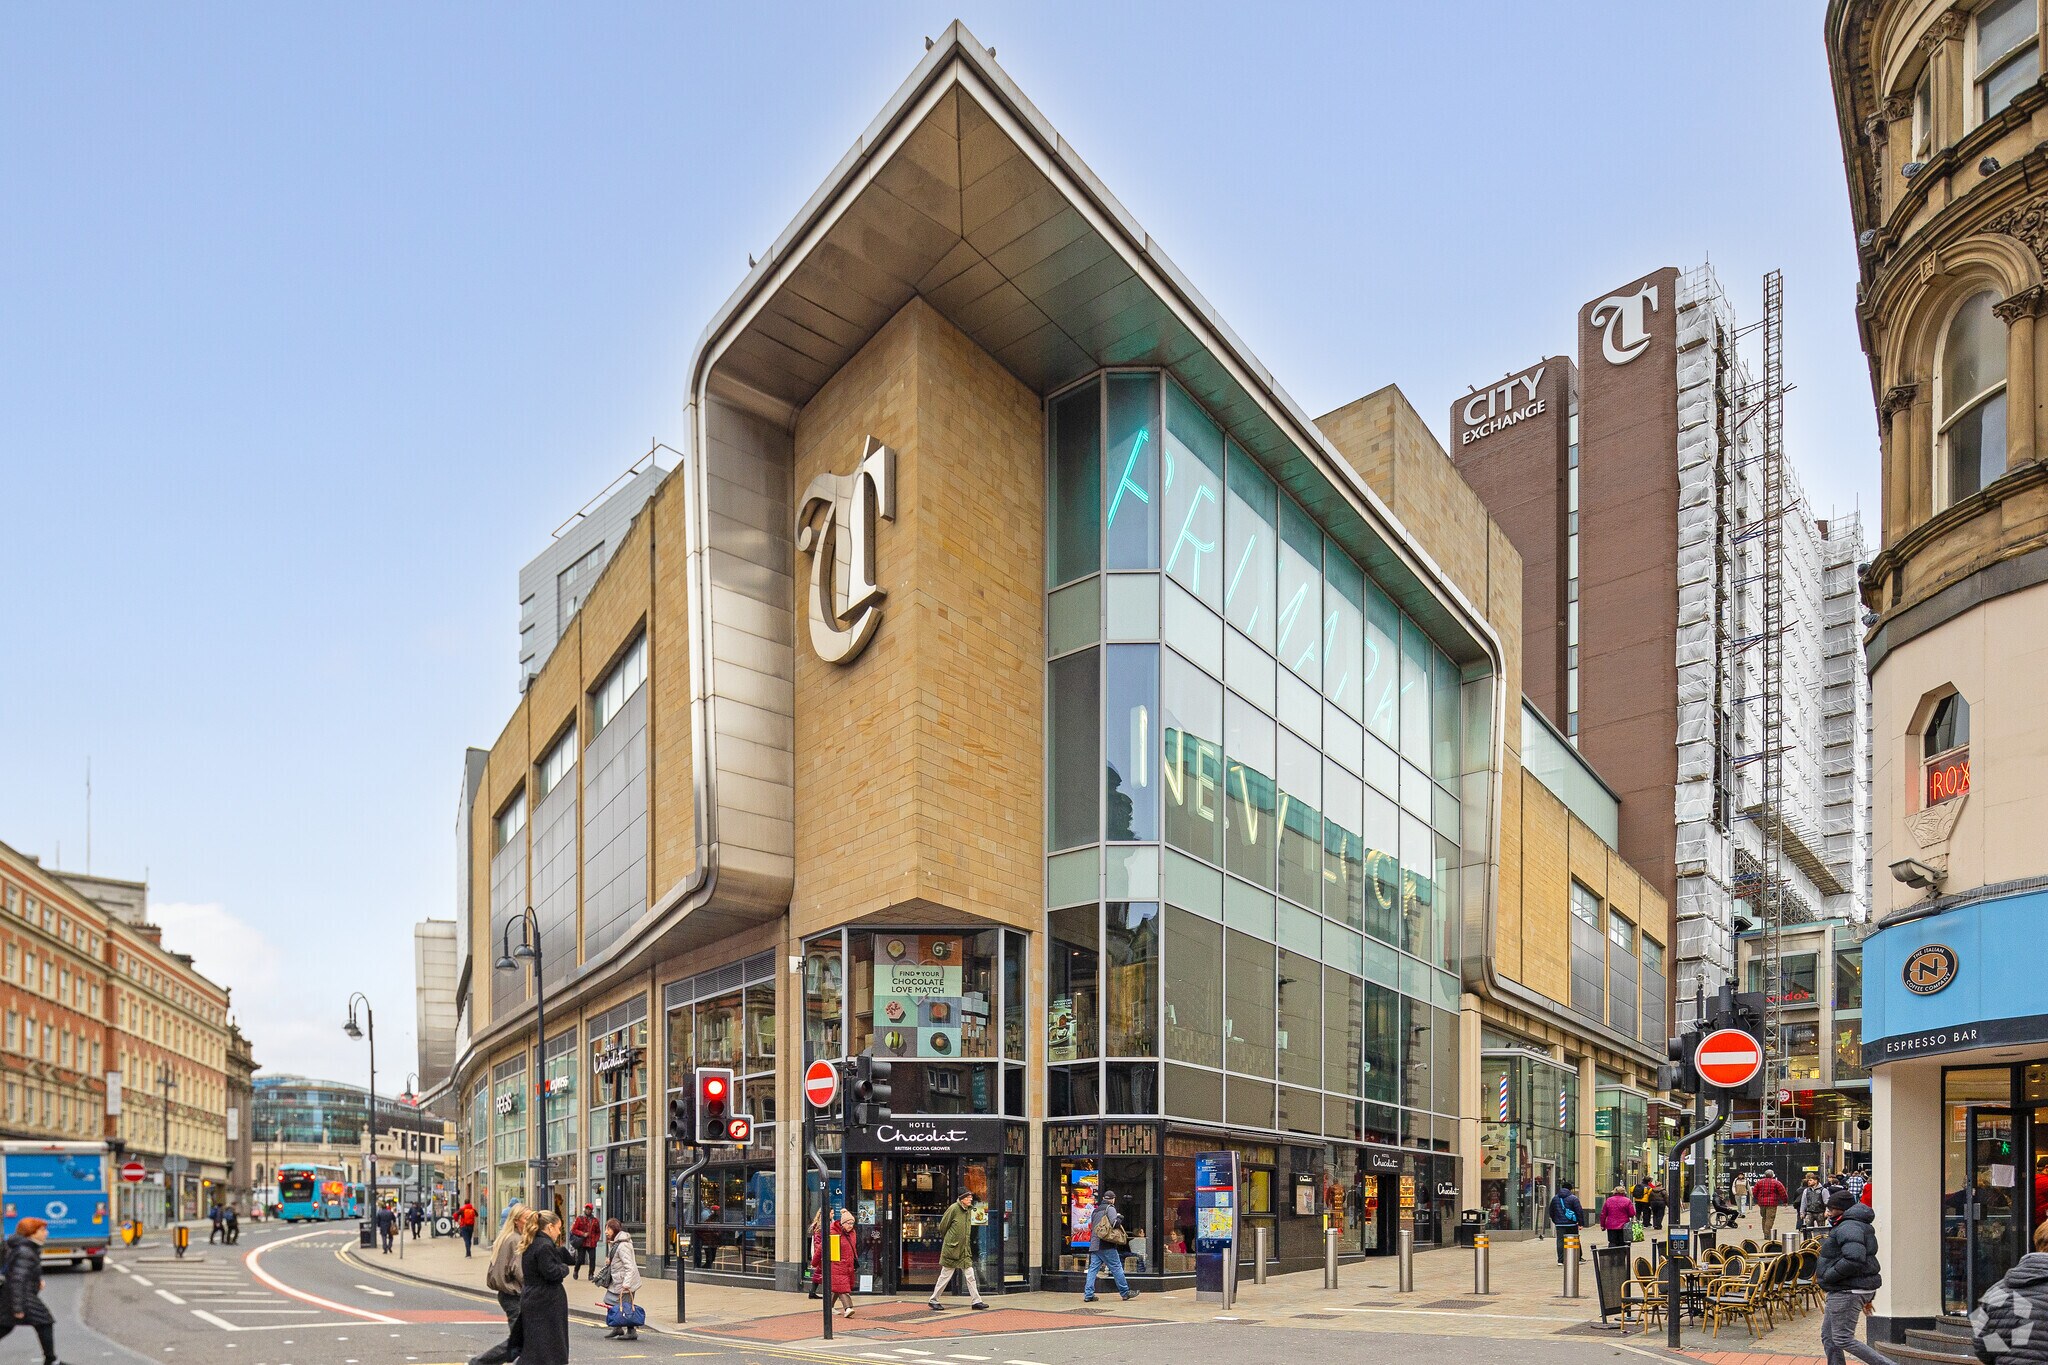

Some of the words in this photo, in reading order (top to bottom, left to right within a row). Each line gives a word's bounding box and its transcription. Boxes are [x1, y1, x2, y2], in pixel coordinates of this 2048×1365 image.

[1463, 366, 1545, 425] CITY
[1462, 399, 1545, 445] EXCHANGE
[1913, 950, 1923, 959] THE
[892, 978, 944, 986] CHOCOLATE
[914, 986, 945, 994] MATCH
[1906, 979, 1923, 992] COFFEE
[1924, 972, 1951, 992] COMPANY
[1765, 989, 1809, 1003] ado's
[1887, 1034, 1947, 1053] ESPRESSO
[1953, 1029, 1977, 1043] BAR
